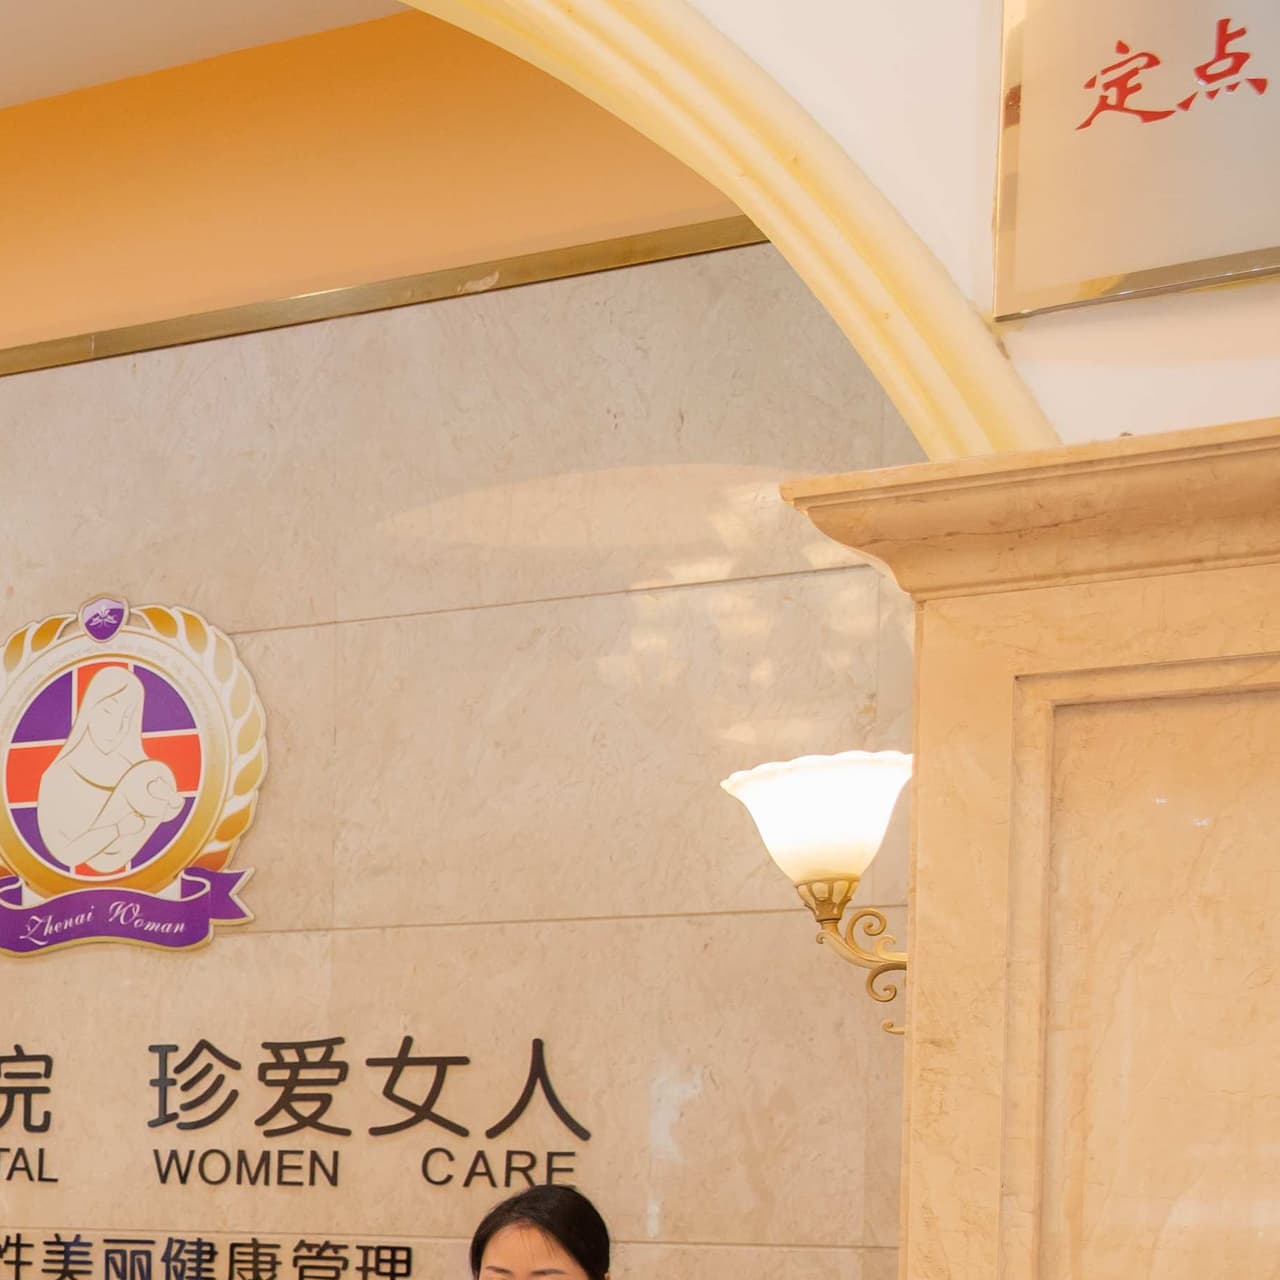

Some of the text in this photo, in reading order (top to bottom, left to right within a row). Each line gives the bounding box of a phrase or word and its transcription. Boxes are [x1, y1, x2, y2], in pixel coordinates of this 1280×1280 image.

[1075, 18, 1268, 130] 定点
[18, 900, 187, 945] Zhenai Woman
[147, 1035, 591, 1142] 珍爱女人
[153, 1148, 339, 1188] WOMEN
[421, 1146, 577, 1188] CARE
